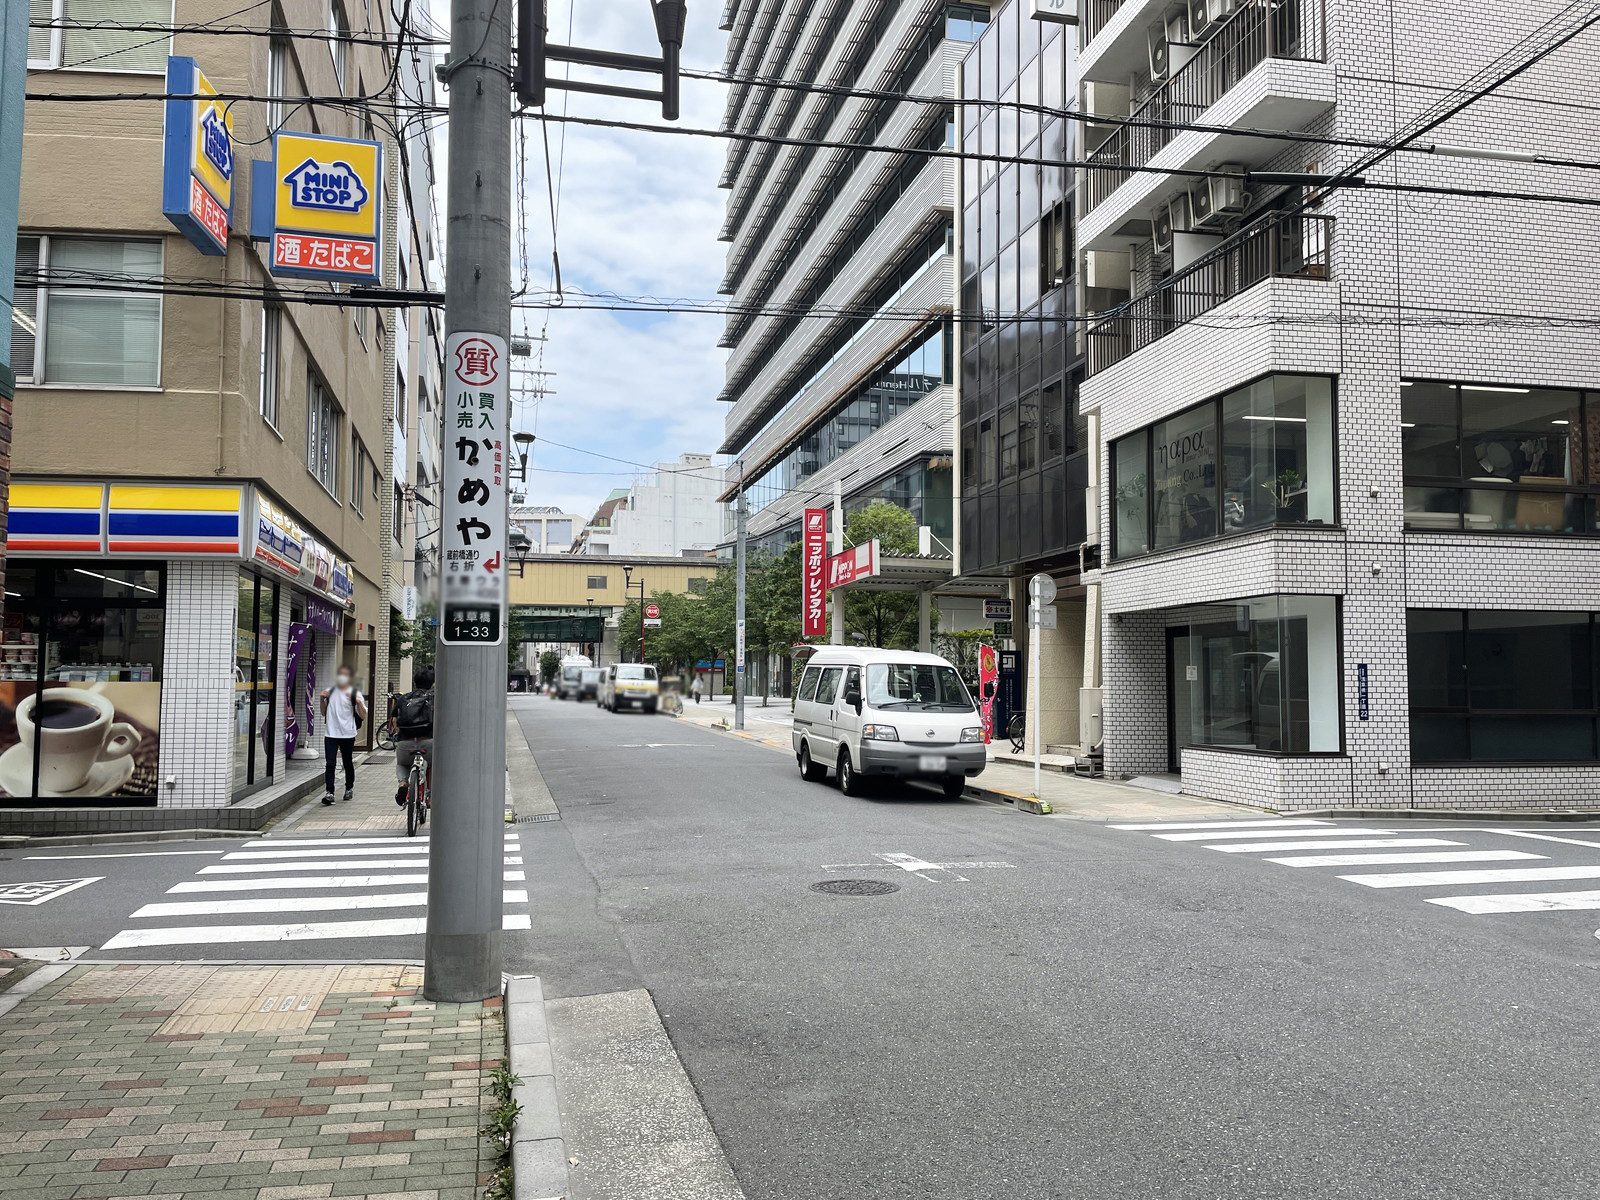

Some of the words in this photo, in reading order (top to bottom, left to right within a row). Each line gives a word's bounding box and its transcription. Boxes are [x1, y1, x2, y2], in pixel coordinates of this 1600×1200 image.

[304, 171, 350, 190] MINI
[301, 186, 352, 205] STOP
[463, 347, 490, 377] 質
[455, 436, 494, 546] かめや
[449, 560, 475, 573] 右折
[838, 560, 854, 575] NIPPON
[808, 535, 823, 630] ニッポンレンタカー
[454, 626, 489, 638] 1-33
